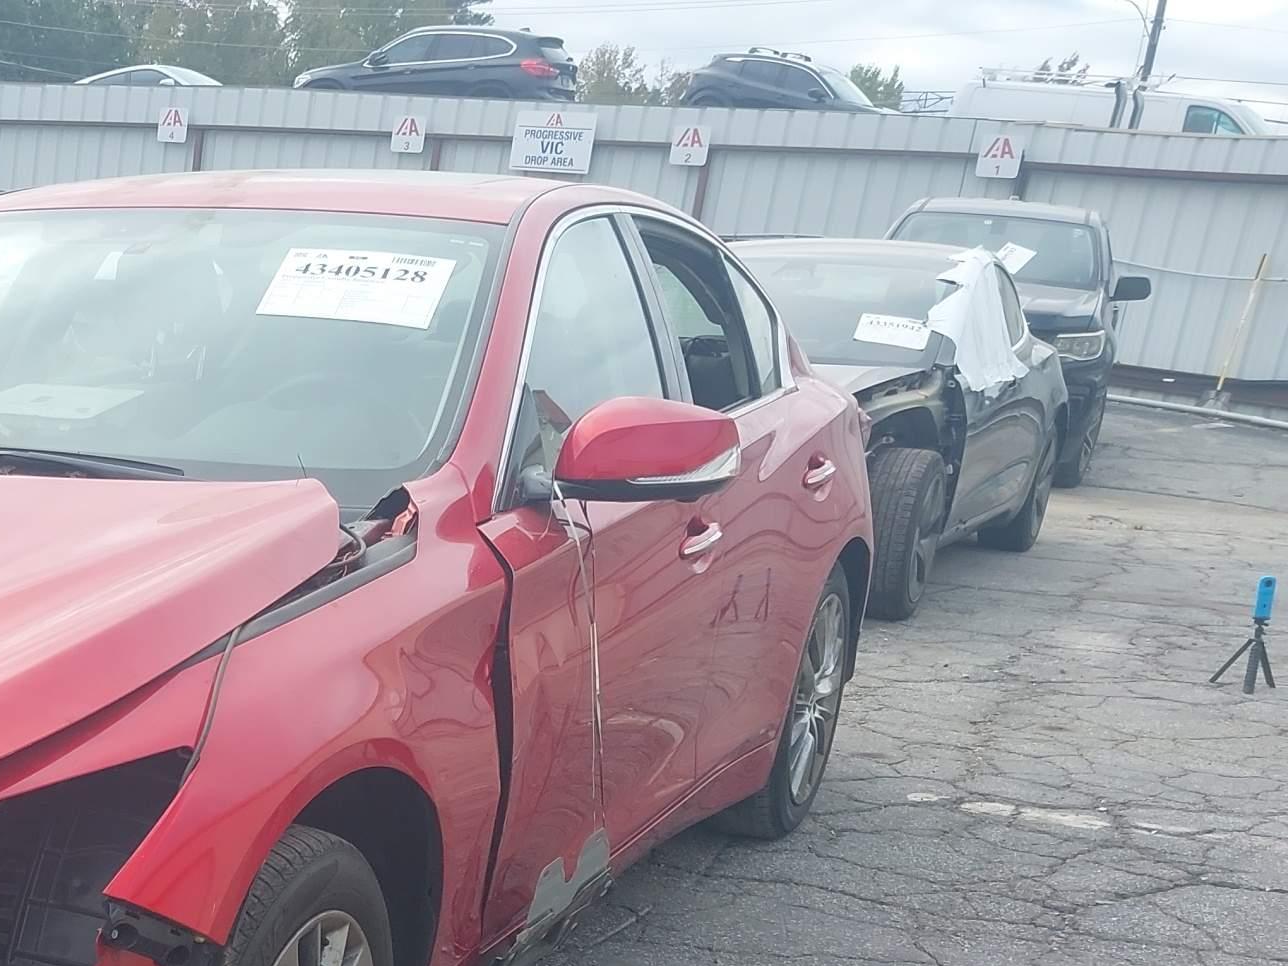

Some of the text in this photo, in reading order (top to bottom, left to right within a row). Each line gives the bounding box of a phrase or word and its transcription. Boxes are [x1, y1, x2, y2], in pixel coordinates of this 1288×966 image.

[169, 131, 175, 140] 4
[524, 129, 584, 141] PROGRESSIVE
[404, 141, 410, 151] 3
[540, 141, 564, 155] VIC
[524, 155, 574, 167] DROP AREA
[684, 153, 692, 163] 2
[994, 165, 1000, 176] 1
[295, 262, 428, 283] 43405128
